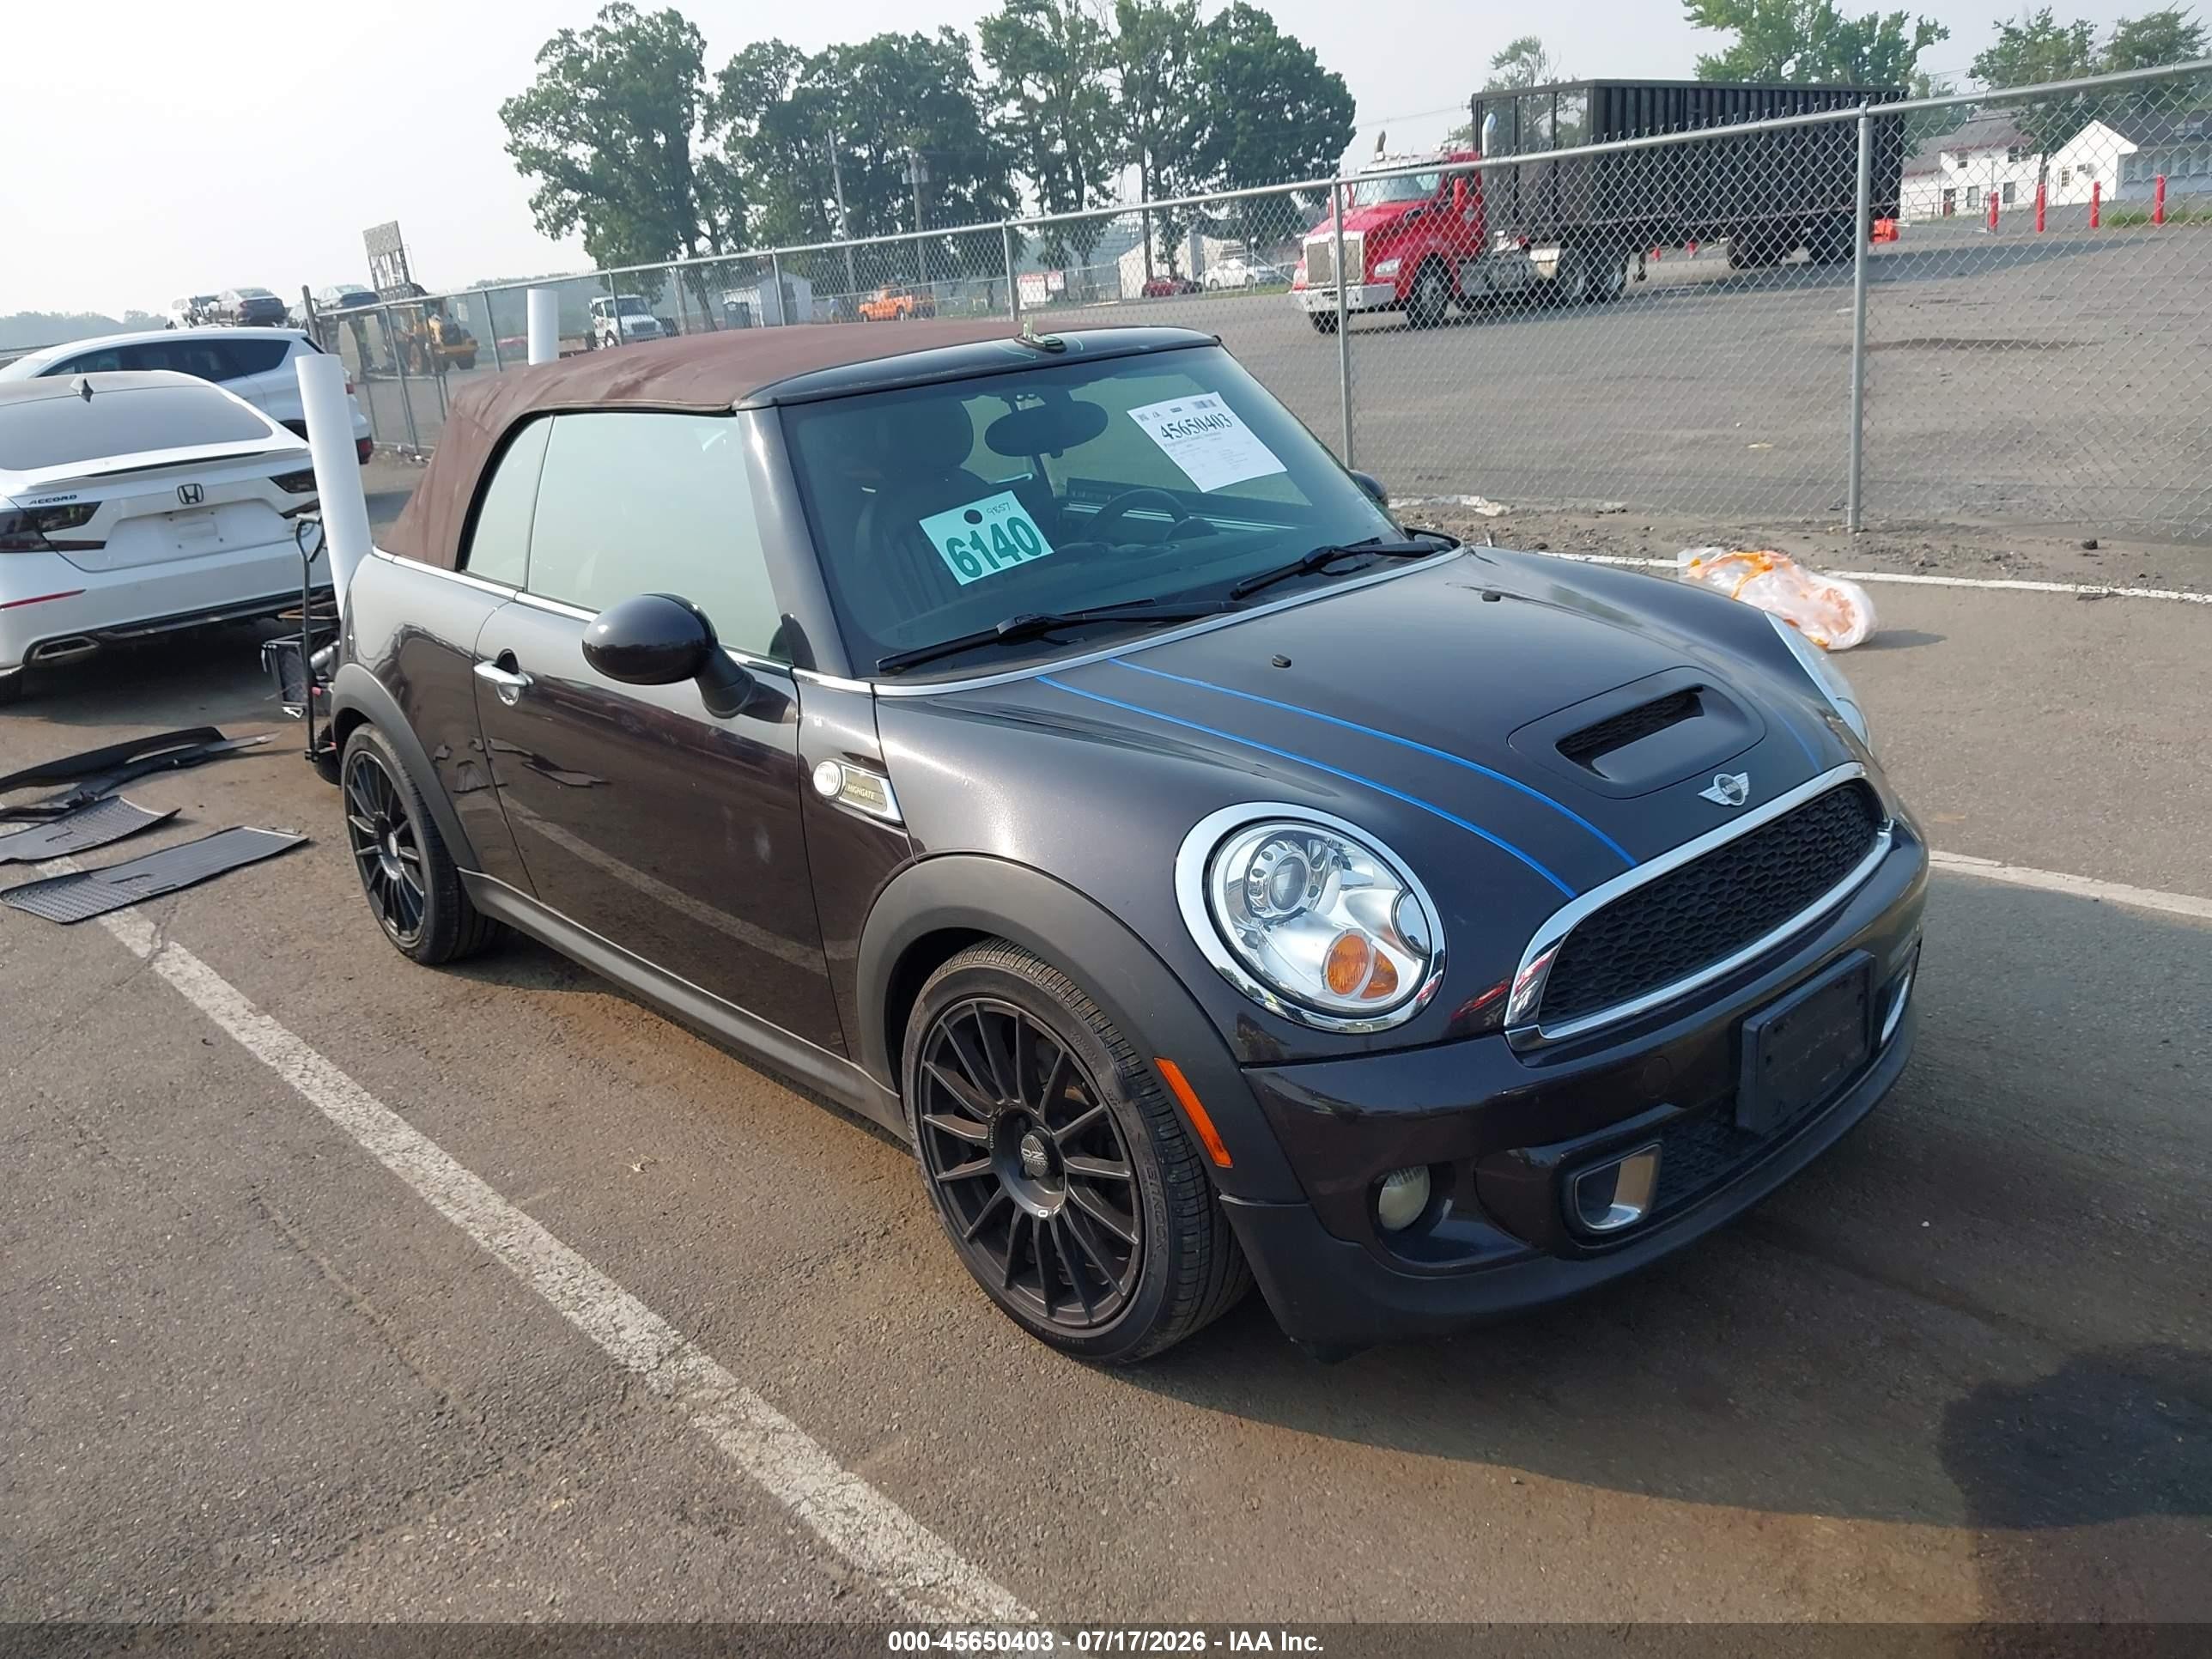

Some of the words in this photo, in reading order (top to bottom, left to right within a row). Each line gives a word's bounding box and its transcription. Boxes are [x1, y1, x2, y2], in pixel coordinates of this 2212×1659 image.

[1161, 413, 1233, 440] 45650403
[28, 495, 77, 505] ACCORD
[946, 517, 1042, 578] 6140
[848, 784, 876, 799] HIGHGATE
